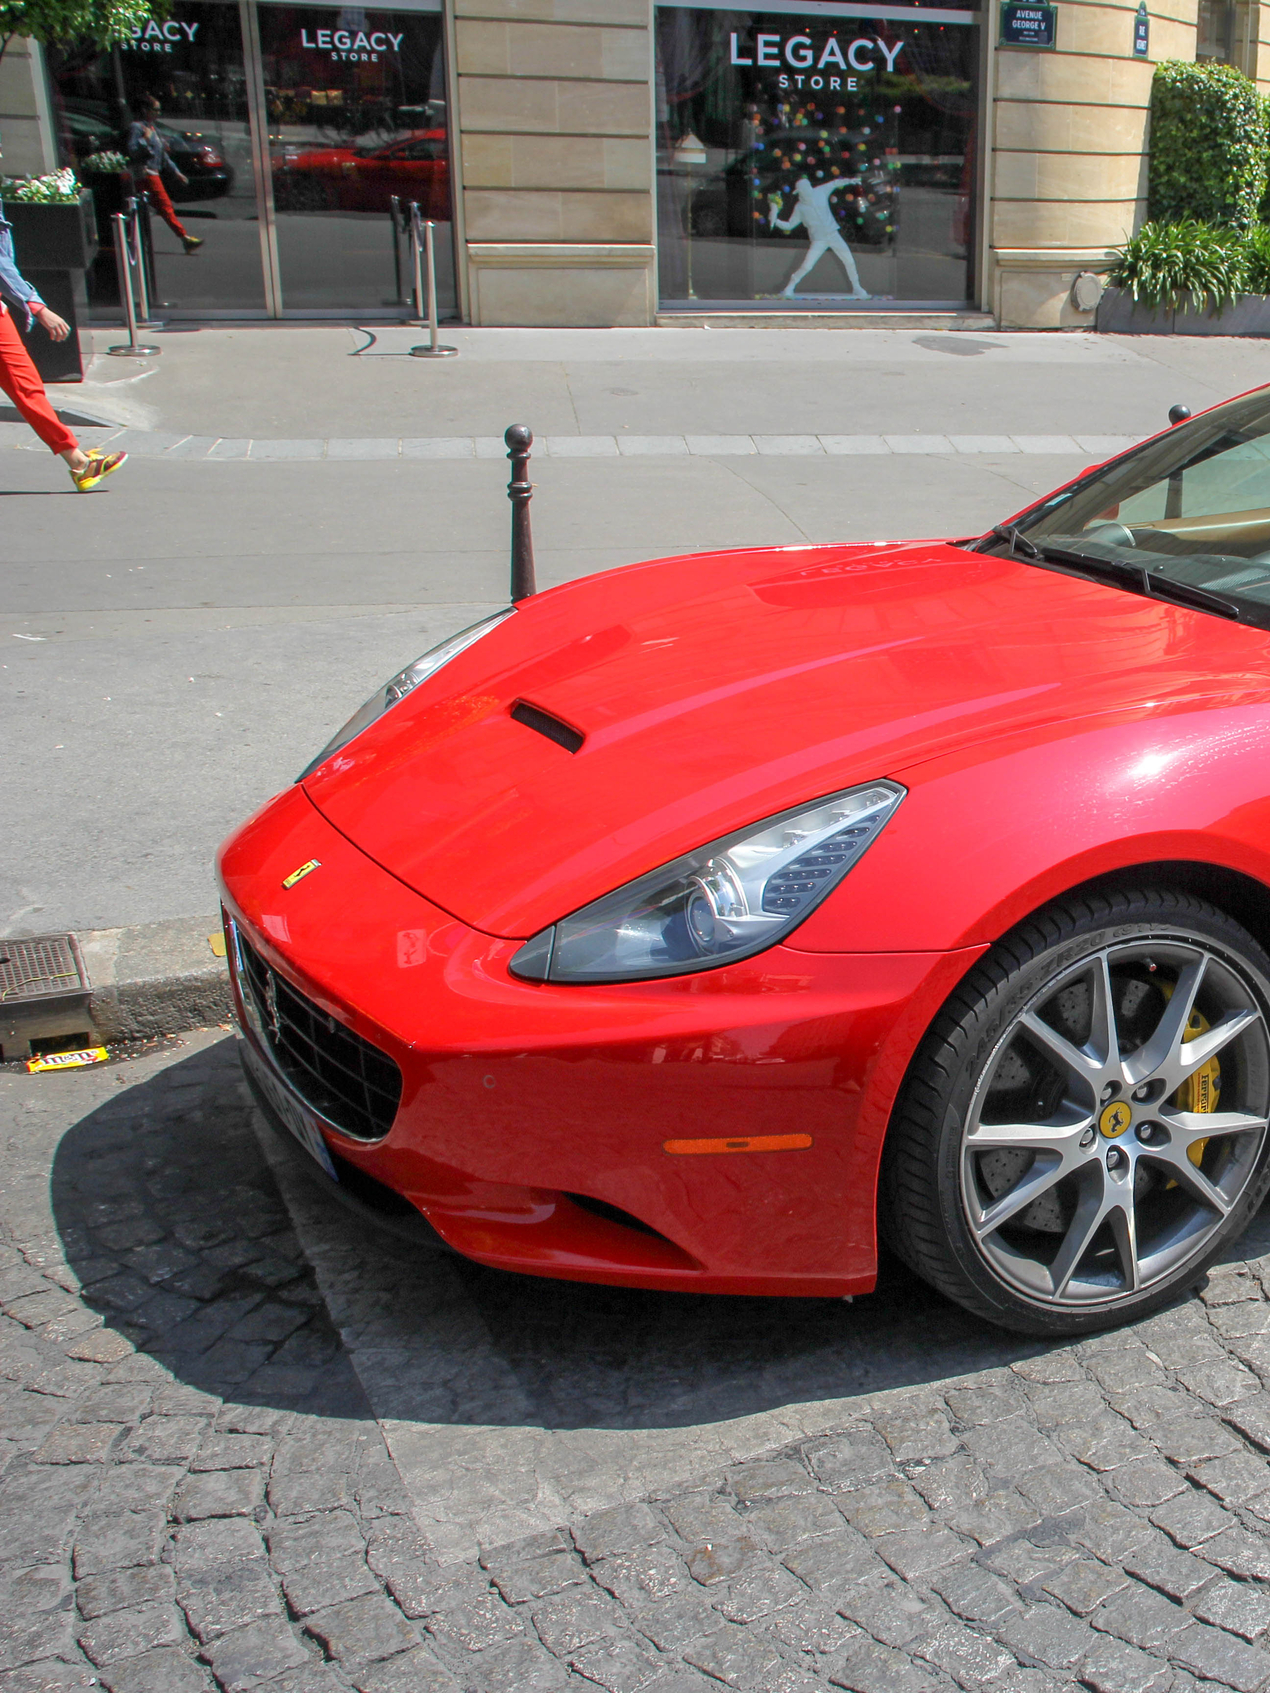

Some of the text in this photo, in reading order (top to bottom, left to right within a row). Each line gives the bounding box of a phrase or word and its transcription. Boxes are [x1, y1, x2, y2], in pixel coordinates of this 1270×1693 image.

[1016, 10, 1043, 20] AVENUE
[1012, 20, 1046, 30] GEORGE V
[301, 28, 403, 51] LEGACY
[121, 41, 172, 52] STORE
[730, 32, 904, 72] LEGACY
[331, 52, 379, 62] STORE
[778, 74, 858, 91] STORE
